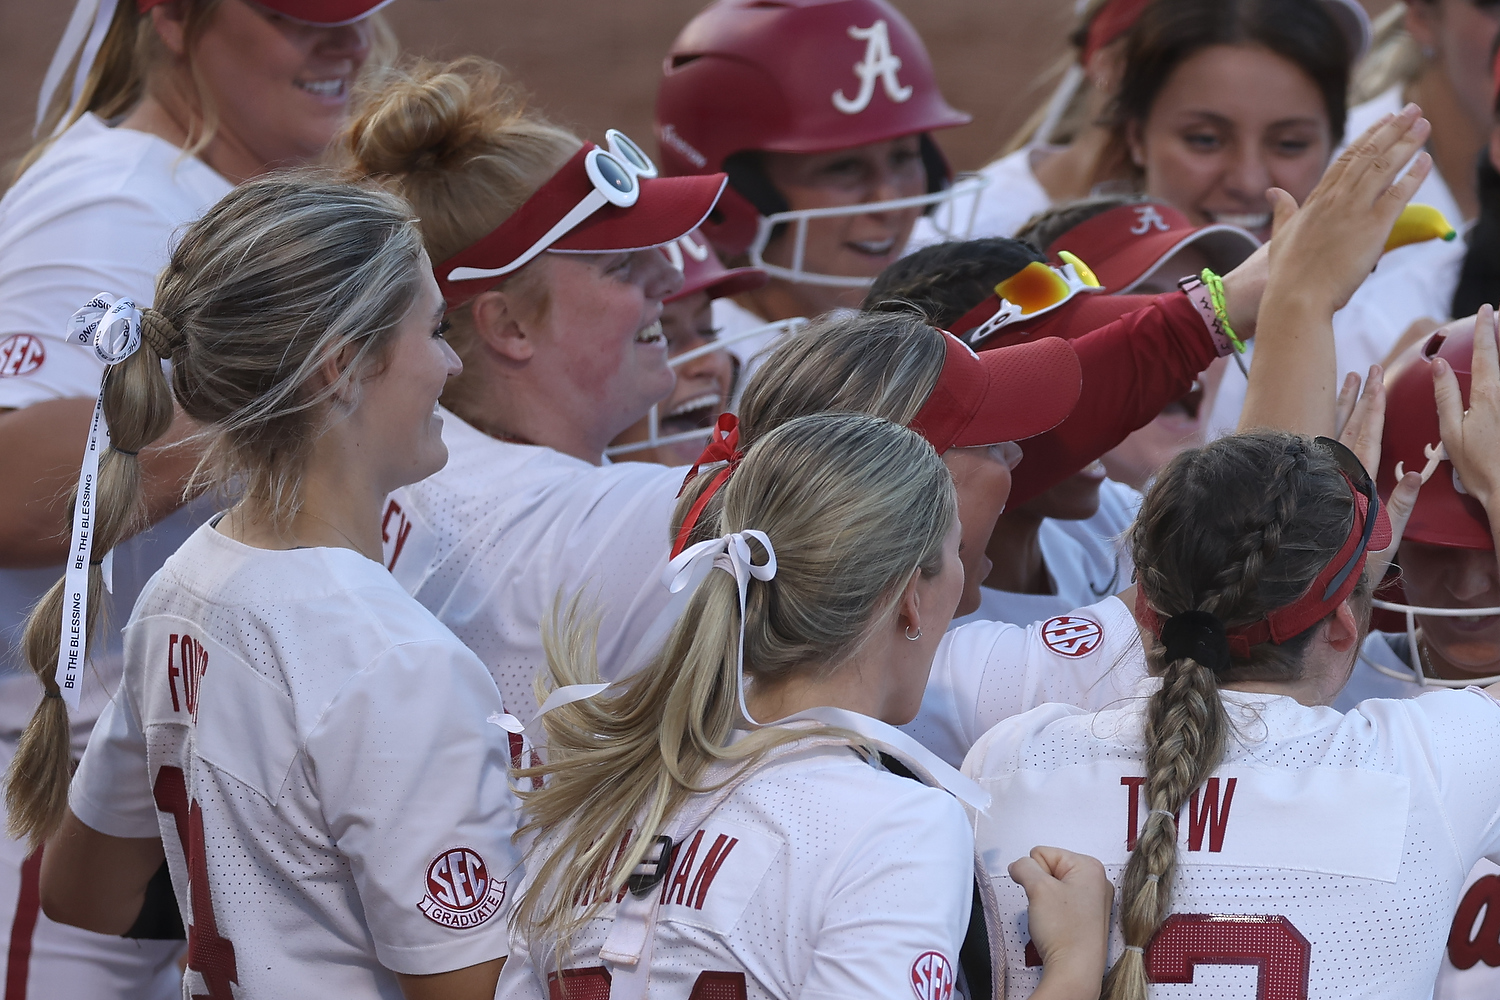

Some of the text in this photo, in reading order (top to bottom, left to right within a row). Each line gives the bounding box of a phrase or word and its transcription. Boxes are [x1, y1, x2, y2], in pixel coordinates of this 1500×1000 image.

[831, 19, 914, 115] A
[75, 474, 93, 570] BE THE BLESSING
[64, 593, 82, 689] BE THE BLESSING
[1044, 617, 1101, 655] SEC
[1121, 776, 1238, 852] TW
[430, 851, 486, 907] SEC
[431, 895, 500, 927] GRADUATE
